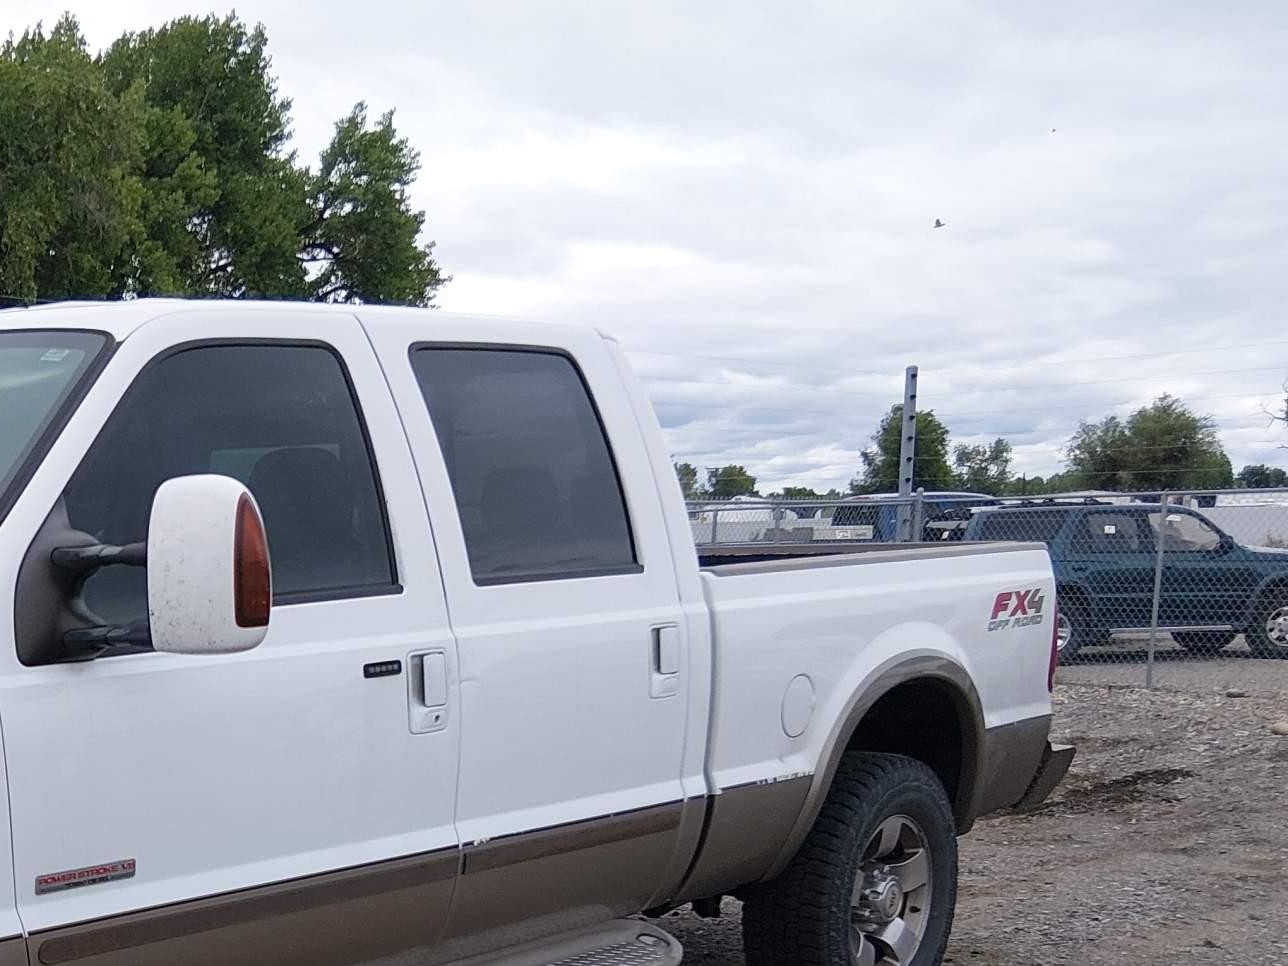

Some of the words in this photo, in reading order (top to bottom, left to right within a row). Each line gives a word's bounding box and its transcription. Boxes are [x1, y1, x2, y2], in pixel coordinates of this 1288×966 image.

[990, 588, 1045, 620] FX4
[987, 619, 1010, 632] OFF
[1012, 614, 1043, 628] ROAD
